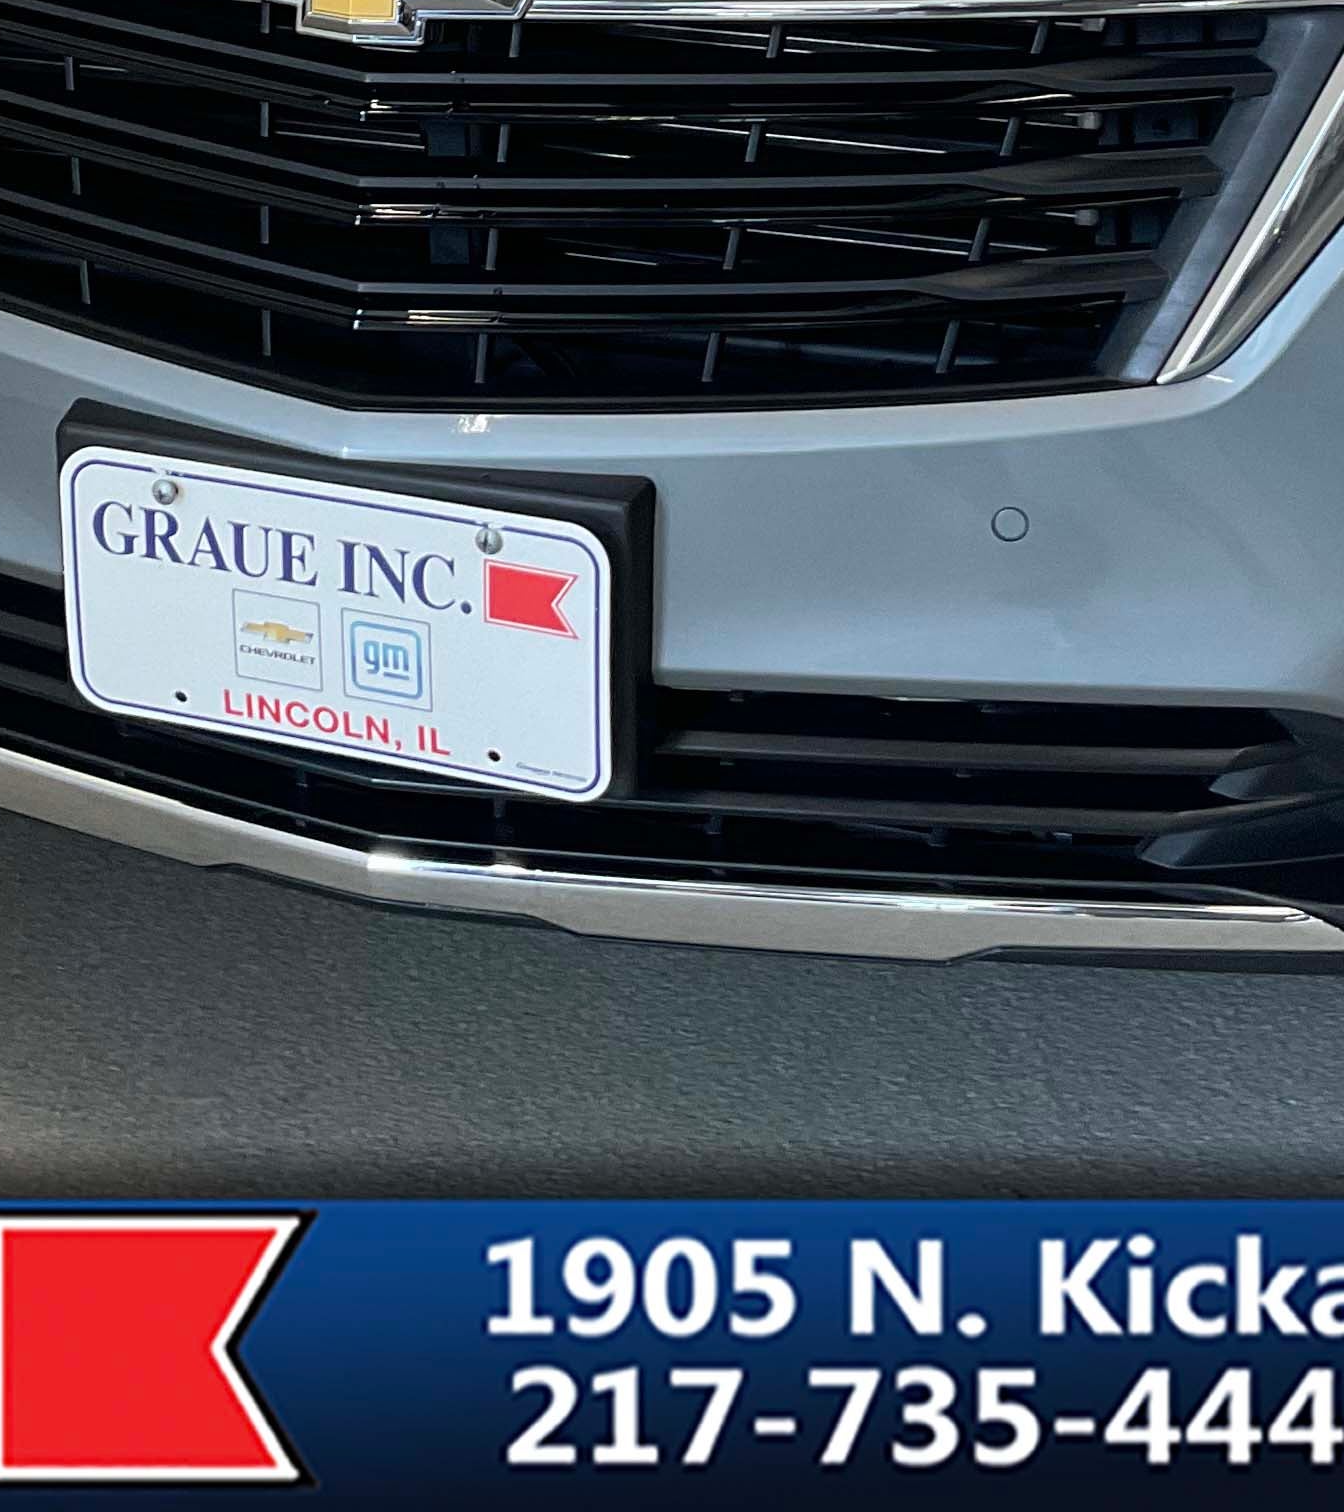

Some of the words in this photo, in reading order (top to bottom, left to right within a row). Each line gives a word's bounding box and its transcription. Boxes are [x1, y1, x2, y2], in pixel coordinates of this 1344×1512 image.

[91, 500, 318, 587] GRAUE
[337, 539, 473, 615] INC.
[239, 644, 317, 665] CHEVROLET
[363, 639, 411, 678] gm
[223, 689, 402, 751] LINCOLN,
[417, 725, 451, 756] IL
